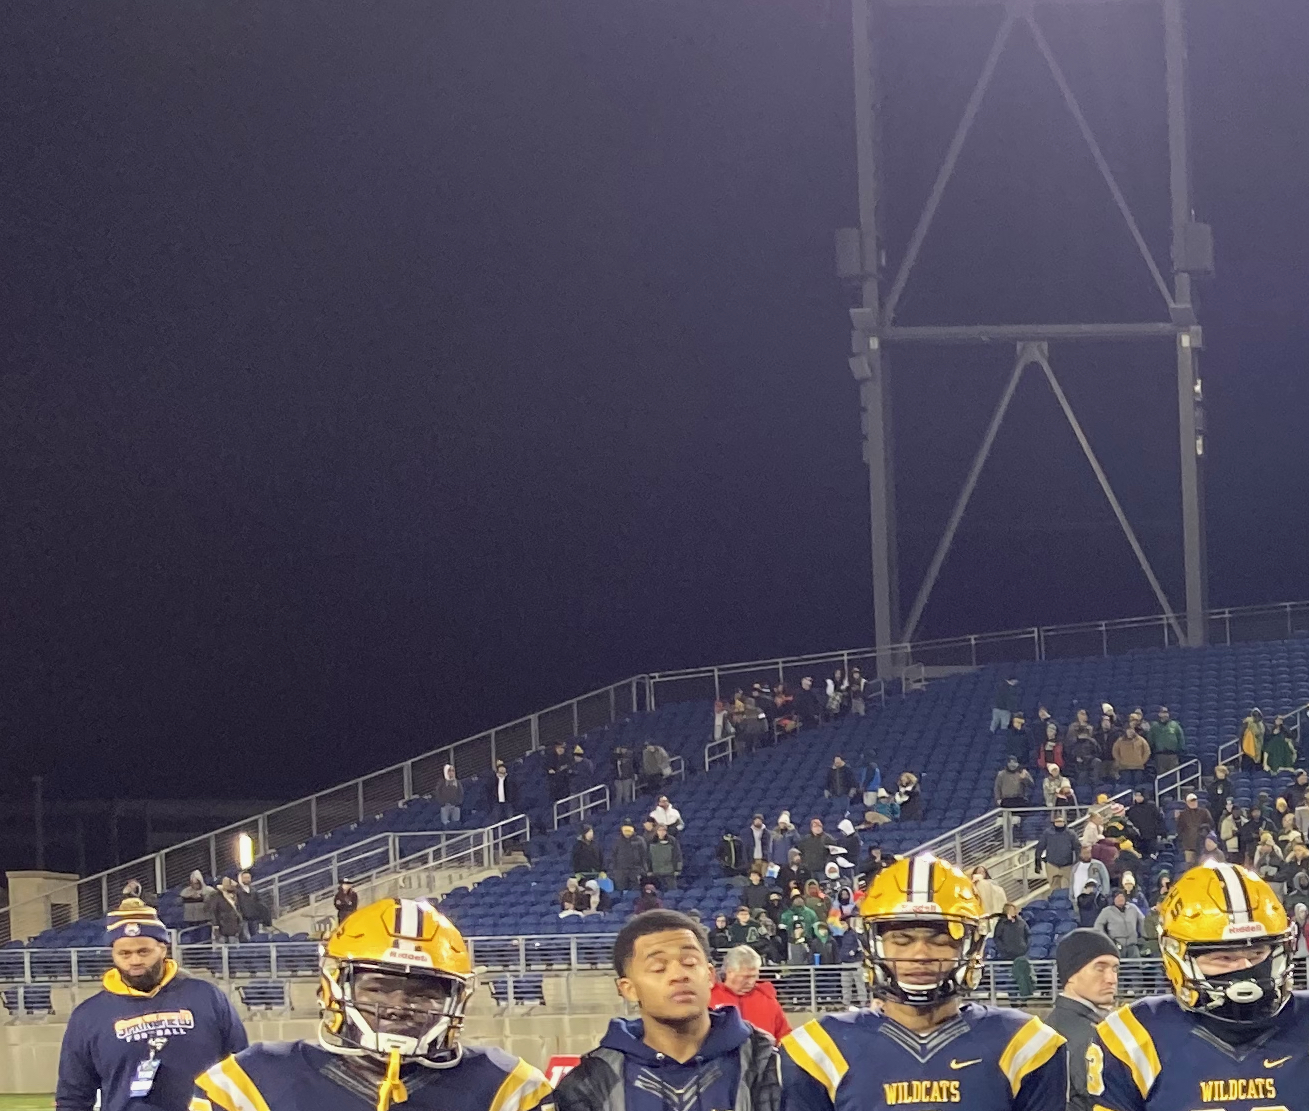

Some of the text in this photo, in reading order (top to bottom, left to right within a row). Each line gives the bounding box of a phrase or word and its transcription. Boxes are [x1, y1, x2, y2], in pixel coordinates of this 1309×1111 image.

[1229, 924, 1262, 934] Riddell
[884, 1080, 961, 1105] WILDCATS
[1200, 1078, 1276, 1103] WILDCATS
